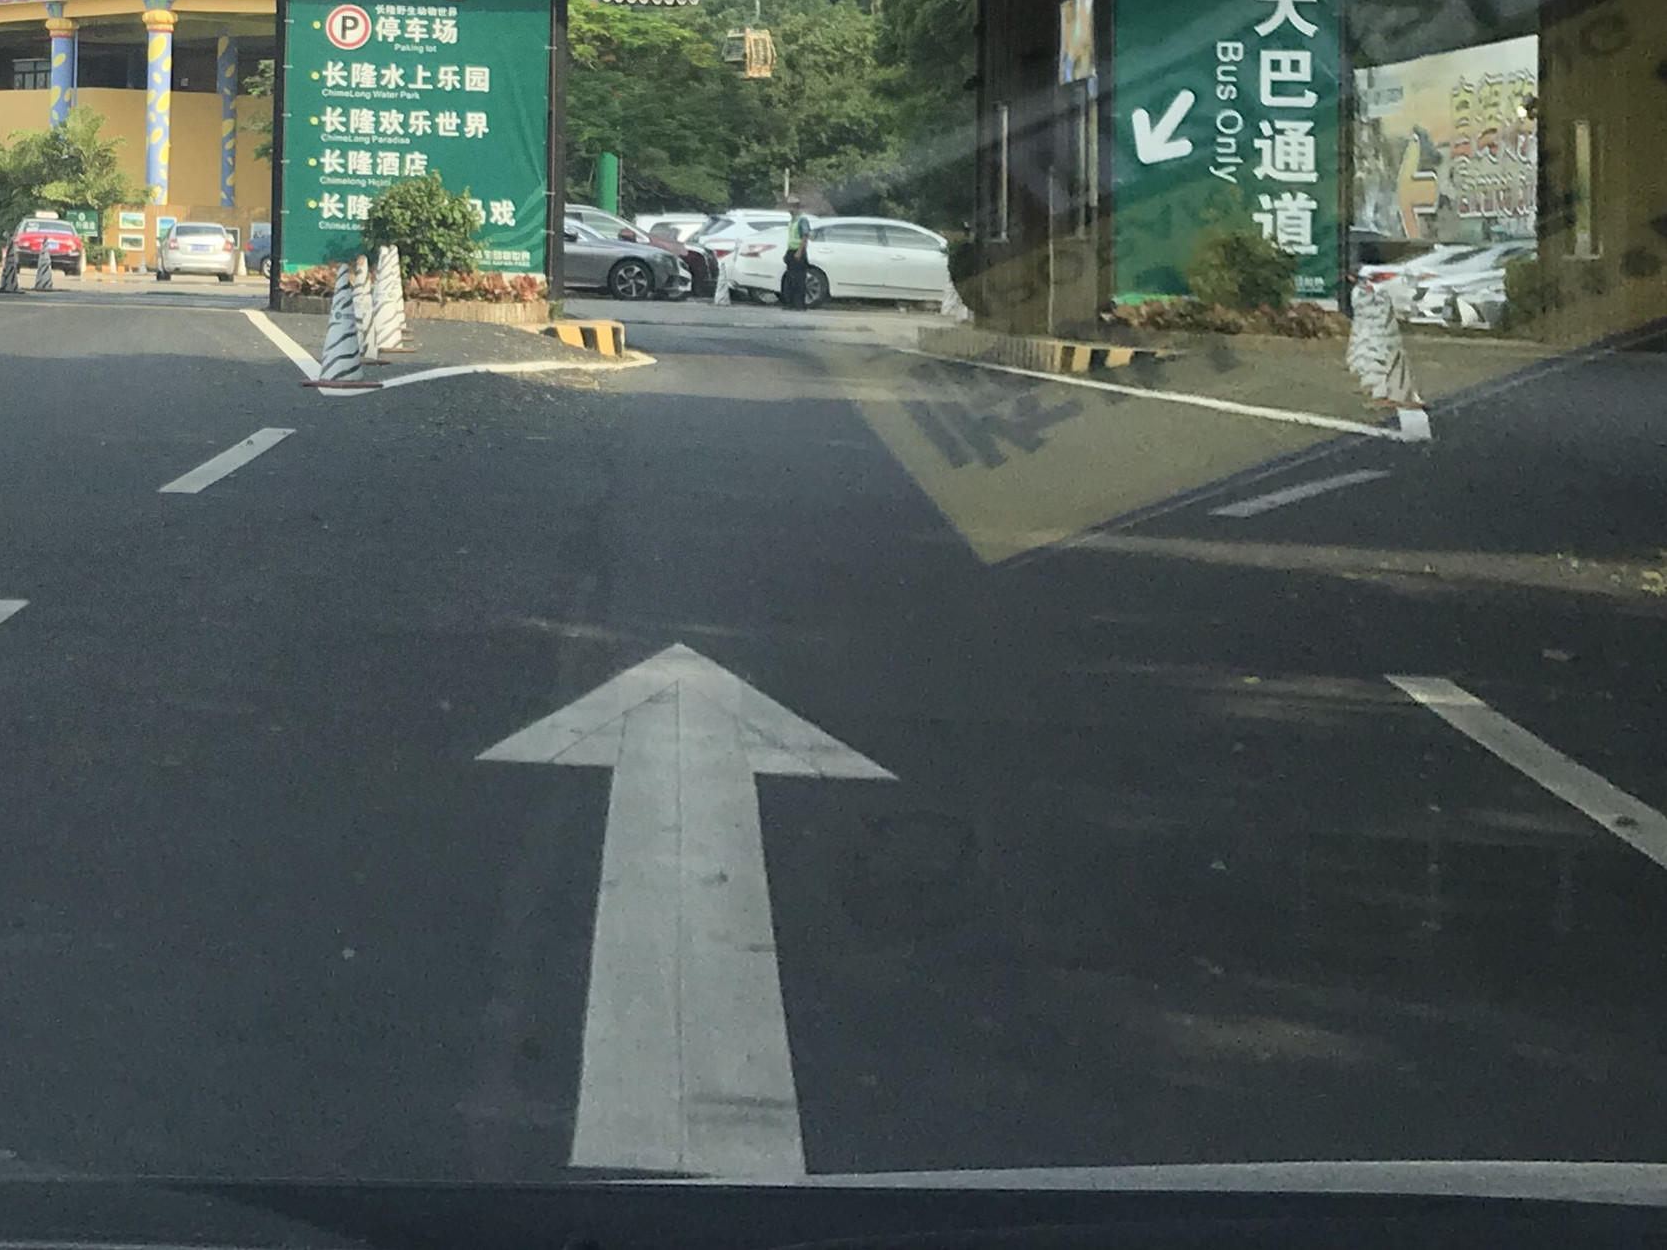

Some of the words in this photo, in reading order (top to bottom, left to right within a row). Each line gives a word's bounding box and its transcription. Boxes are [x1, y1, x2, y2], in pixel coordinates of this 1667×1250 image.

[341, 15, 360, 40] P
[375, 16, 458, 44] 停车场
[322, 60, 490, 92] 长隆水上乐园
[1215, 40, 1245, 101] Bus
[320, 106, 490, 139] 长隆欢乐世界
[319, 148, 429, 177] 长隆酒店
[1208, 109, 1245, 184] Only
